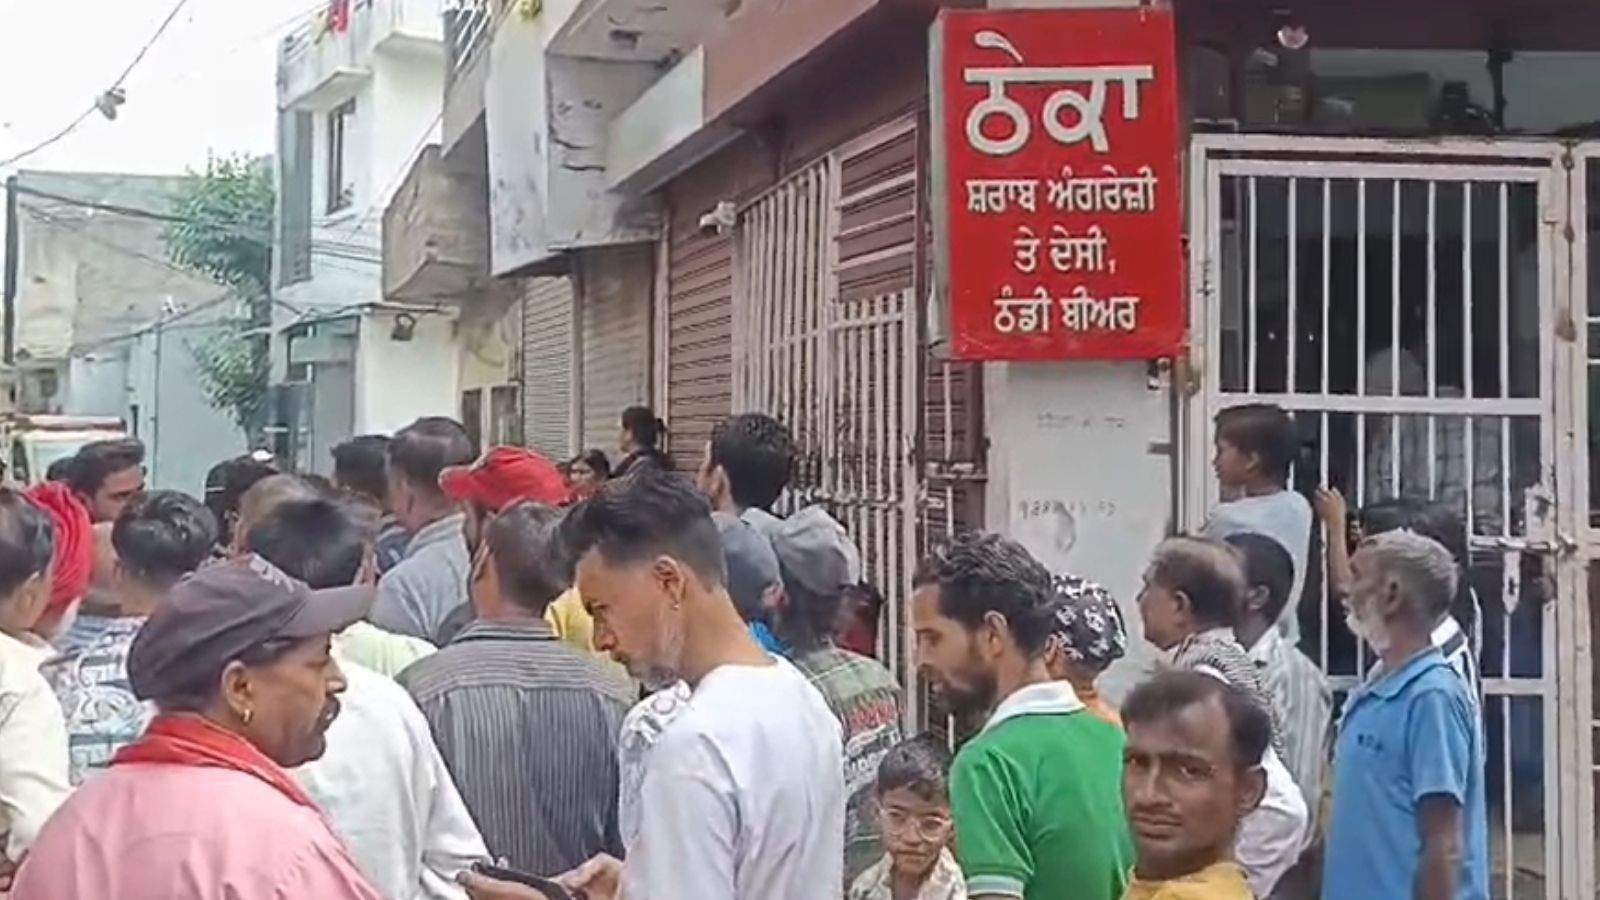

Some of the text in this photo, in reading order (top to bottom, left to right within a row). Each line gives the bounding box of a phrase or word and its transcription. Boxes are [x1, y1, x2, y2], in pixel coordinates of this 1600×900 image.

[964, 30, 1153, 154] ਠੇਕਾ
[966, 179, 1039, 212] ਸ਼ਰਾਬ
[1013, 225, 1040, 272] ਤੇ
[993, 284, 1140, 332] ਠੰਡੀ ਬੀਅਰ
